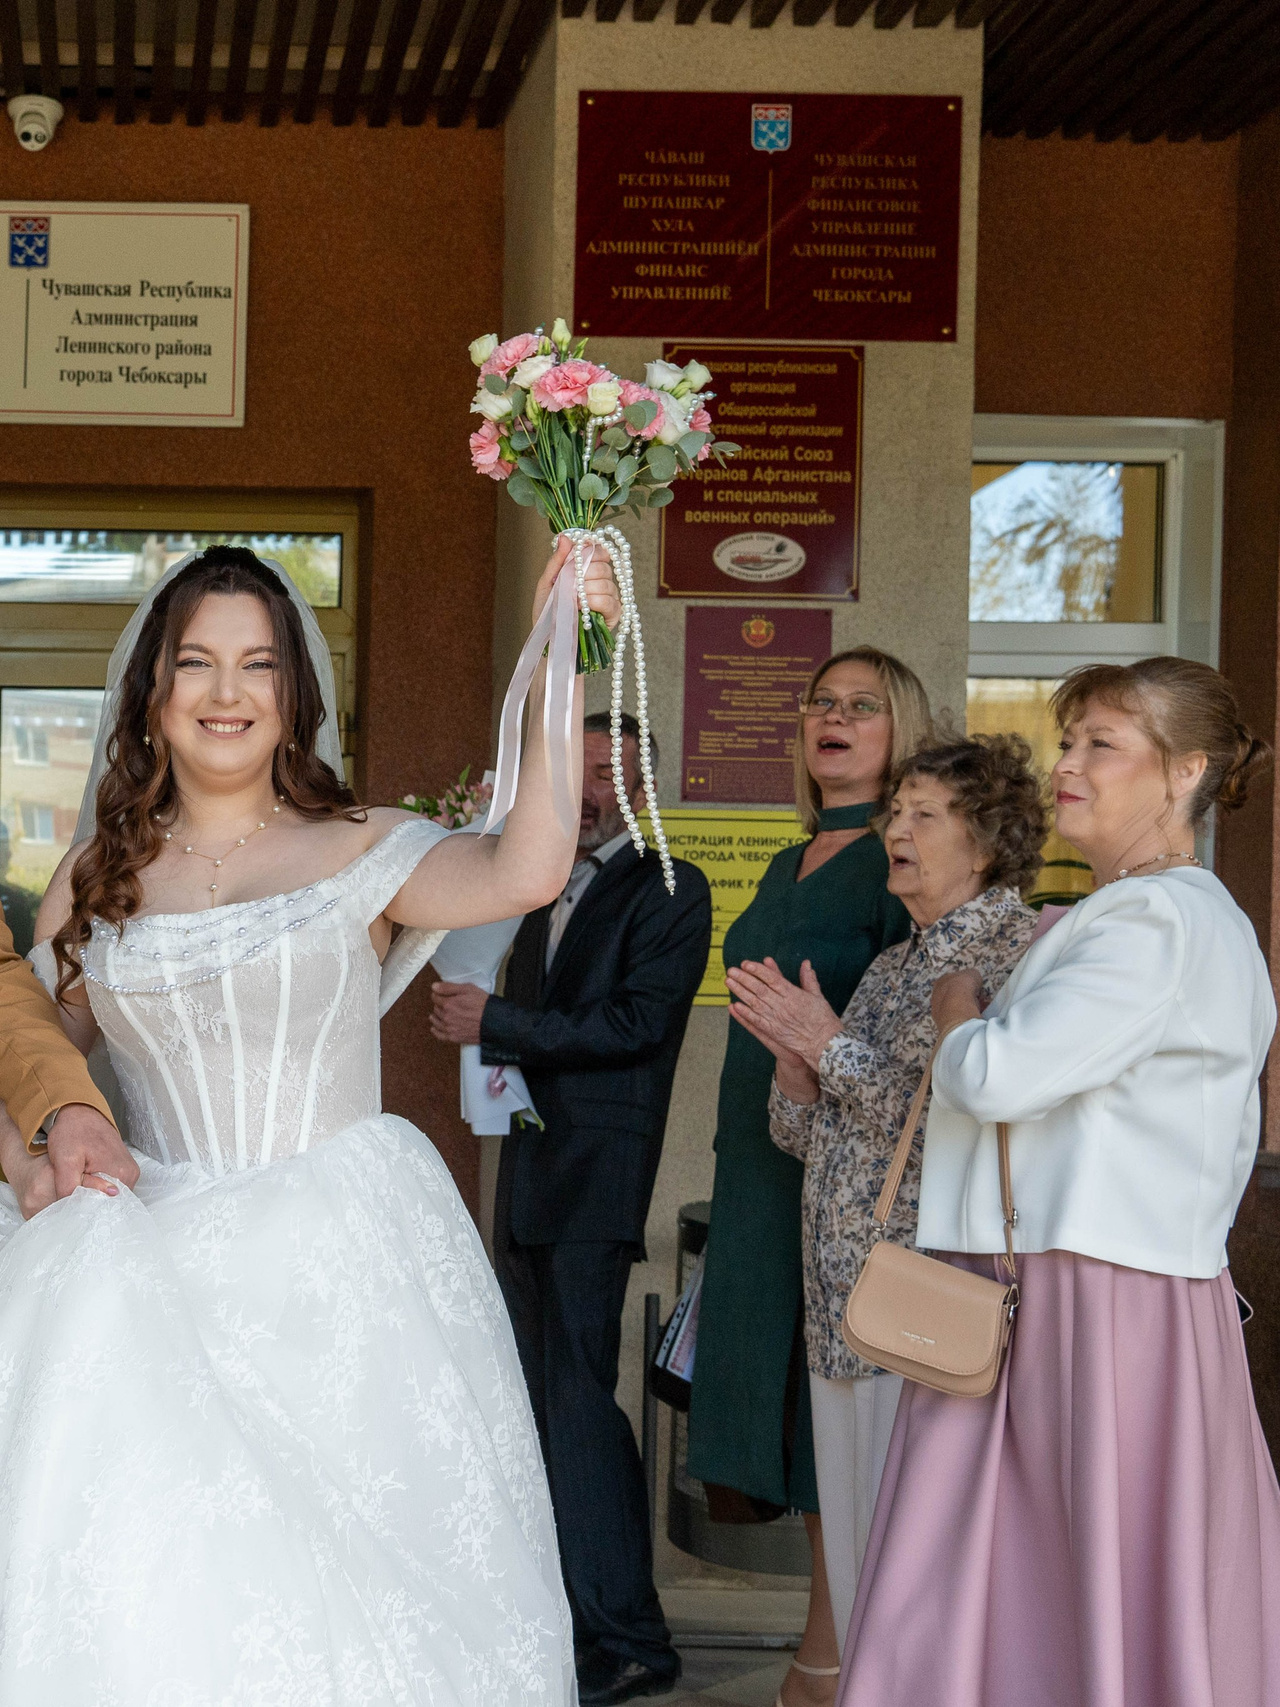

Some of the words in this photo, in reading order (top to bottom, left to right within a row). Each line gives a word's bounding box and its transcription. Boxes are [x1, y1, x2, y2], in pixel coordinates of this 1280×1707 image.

[813, 153, 917, 169] ЧУВАШСКАЯ
[618, 173, 730, 188] РЕСПУБЛИКИ
[811, 176, 919, 191] РЕСПУБЛИКА
[622, 195, 725, 210] ШУПАШКАР
[807, 199, 921, 214] ФИНАНСОВОЕ
[651, 218, 696, 233] ХУЛА
[811, 221, 918, 236] УПРАВЛЕНИЕ
[790, 243, 937, 259] АДМИНИСТРАЦИИ
[634, 263, 709, 278] ФИНАНС
[831, 266, 894, 281] ГОРОДА
[41, 278, 131, 302] Чувашская
[139, 280, 232, 306] Республика
[812, 288, 912, 304] ЧЕБОКСАРЫ
[71, 310, 200, 332] Администрация
[55, 335, 151, 357] Ленинского
[155, 339, 213, 361] района
[748, 360, 837, 376] республиканская
[58, 368, 113, 386] города
[117, 365, 208, 389] Чебоксары
[731, 382, 796, 396] организация
[718, 402, 816, 418] Общероссийской
[770, 425, 843, 438] организации
[794, 445, 833, 461] Союз
[753, 466, 851, 486] Афганистана
[703, 490, 714, 502] и
[717, 490, 819, 506] специальных
[684, 510, 751, 523] военных
[753, 508, 835, 528] операций»
[683, 850, 734, 862] ГОРОДА
